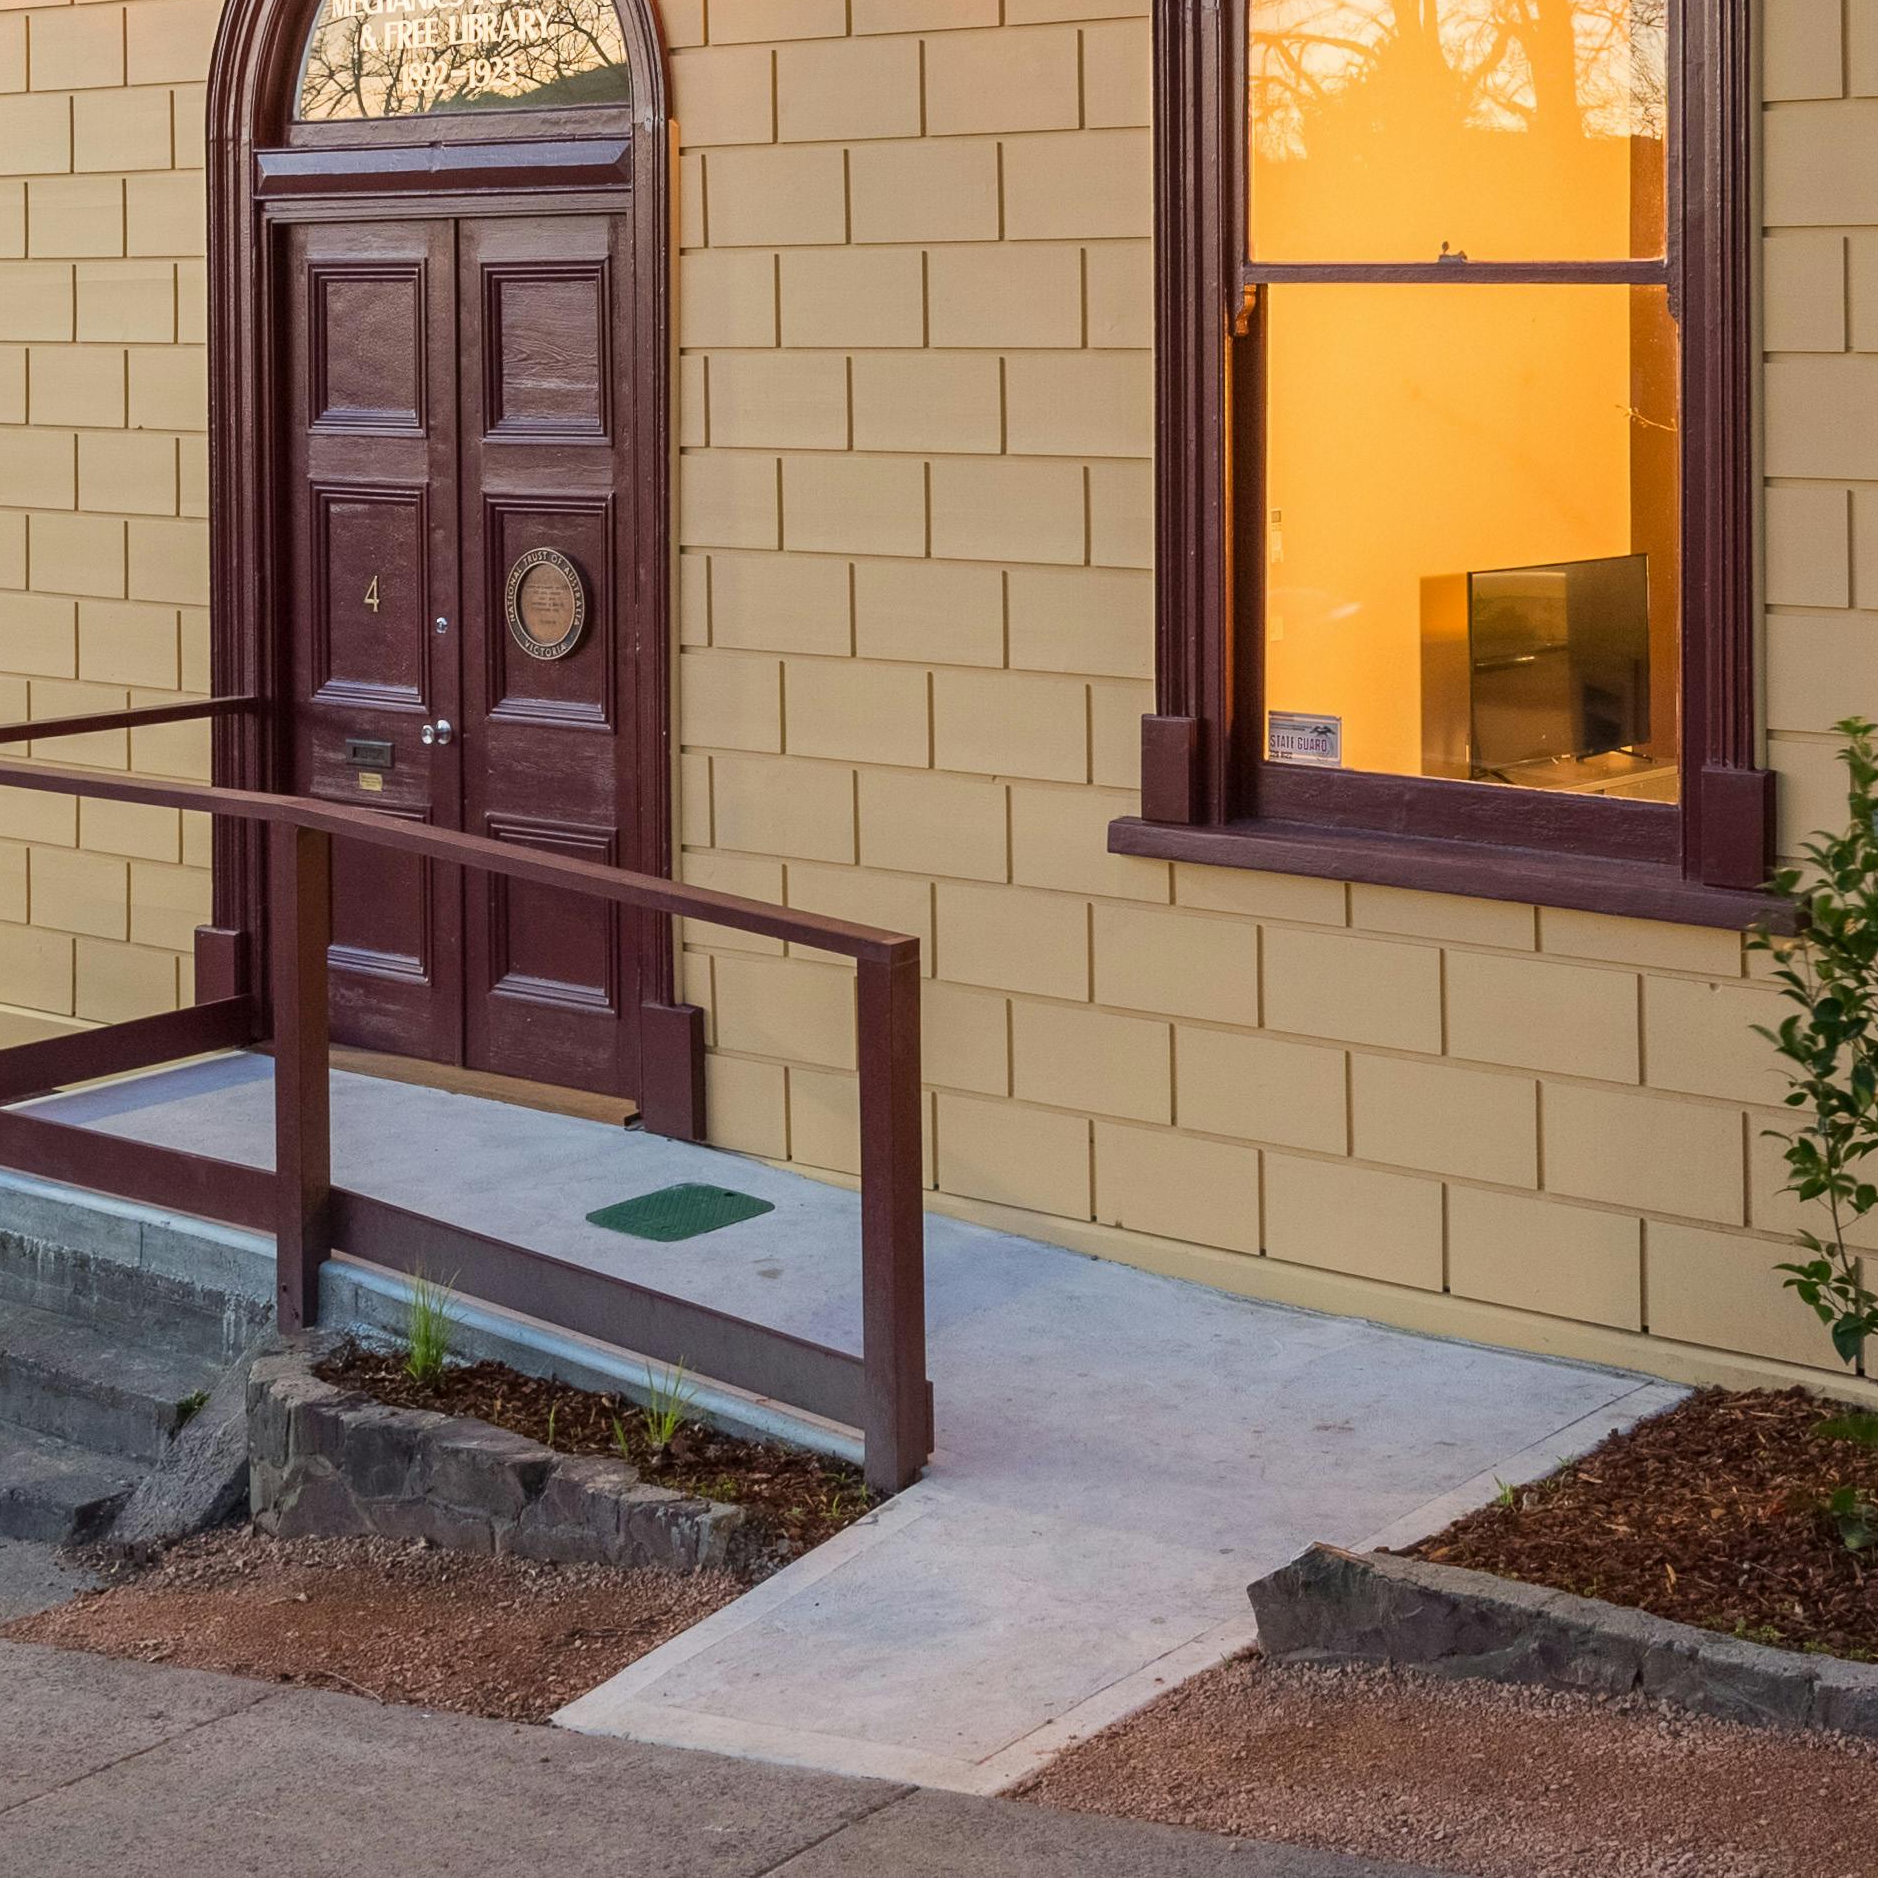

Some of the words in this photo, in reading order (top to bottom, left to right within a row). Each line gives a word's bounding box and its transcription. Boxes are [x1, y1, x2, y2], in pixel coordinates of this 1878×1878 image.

[360, 23, 378, 52] &
[384, 17, 438, 51] FREE
[449, 8, 554, 46] LIBRARY
[363, 575, 380, 613] 4
[507, 568, 522, 623] NATIONAL
[523, 551, 548, 566] TRUST
[551, 554, 563, 564] OF
[564, 567, 583, 626] AUSTRALIA
[525, 640, 568, 657] VICTORIA
[1298, 737, 1327, 752] GUARD
